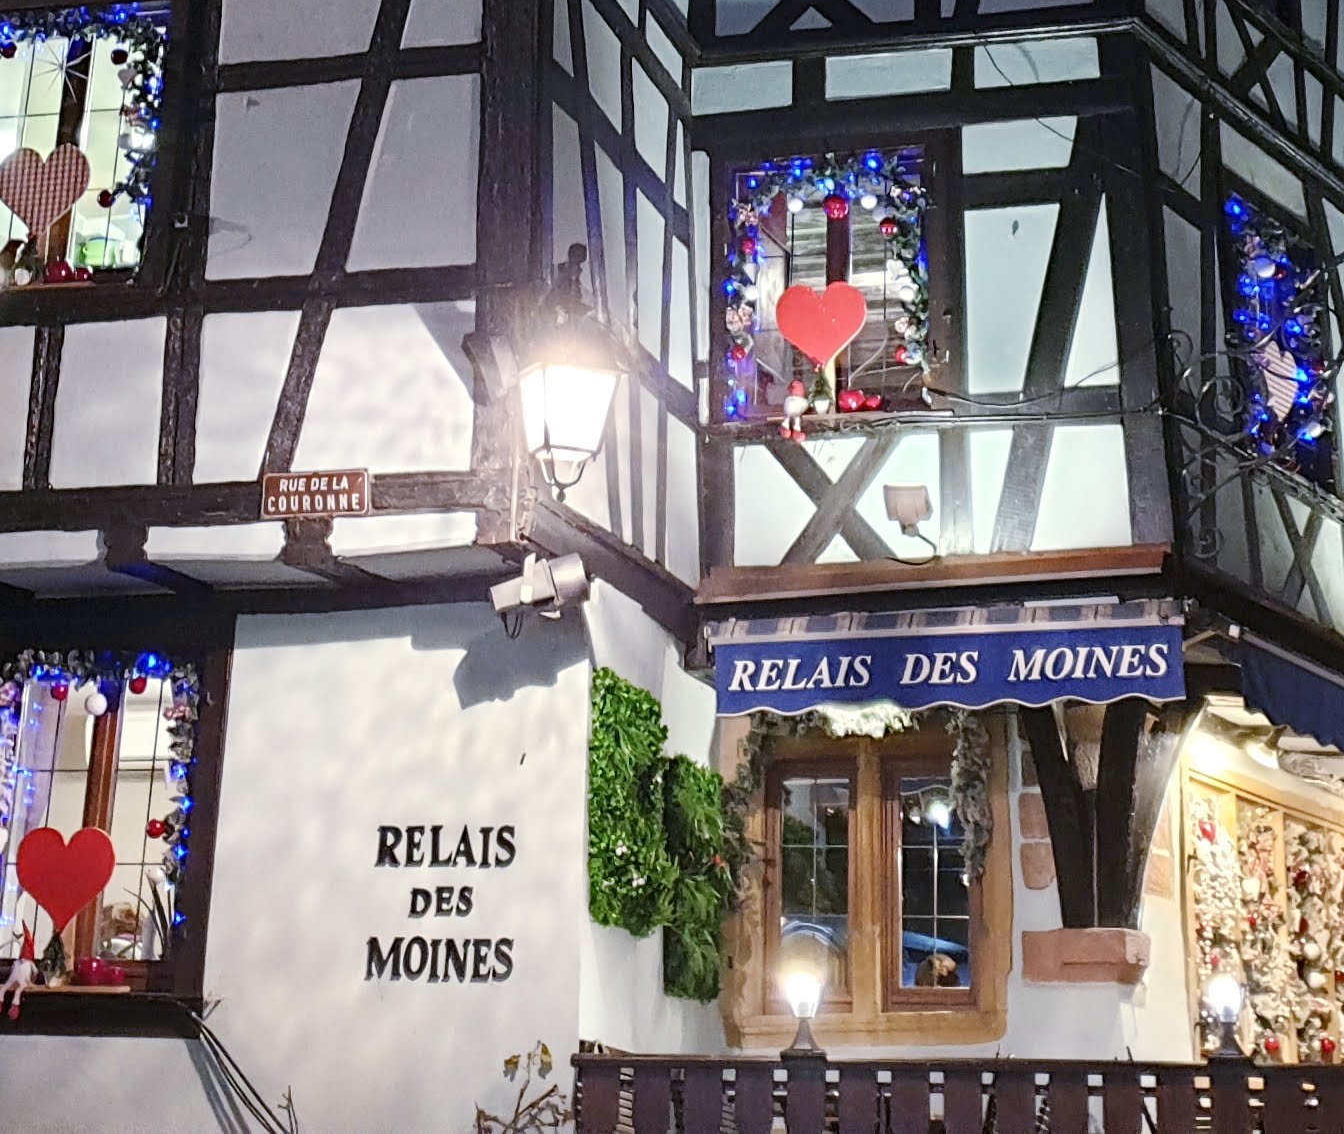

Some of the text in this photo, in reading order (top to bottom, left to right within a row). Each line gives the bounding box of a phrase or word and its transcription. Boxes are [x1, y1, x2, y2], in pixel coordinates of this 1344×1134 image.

[267, 493, 360, 512] COURONNE
[279, 475, 349, 493] RUE DE LA
[728, 643, 1170, 692] RELAIS DES MOINES
[373, 824, 517, 869] RELAIS
[407, 885, 474, 919] DES
[364, 935, 515, 984] MOINES
